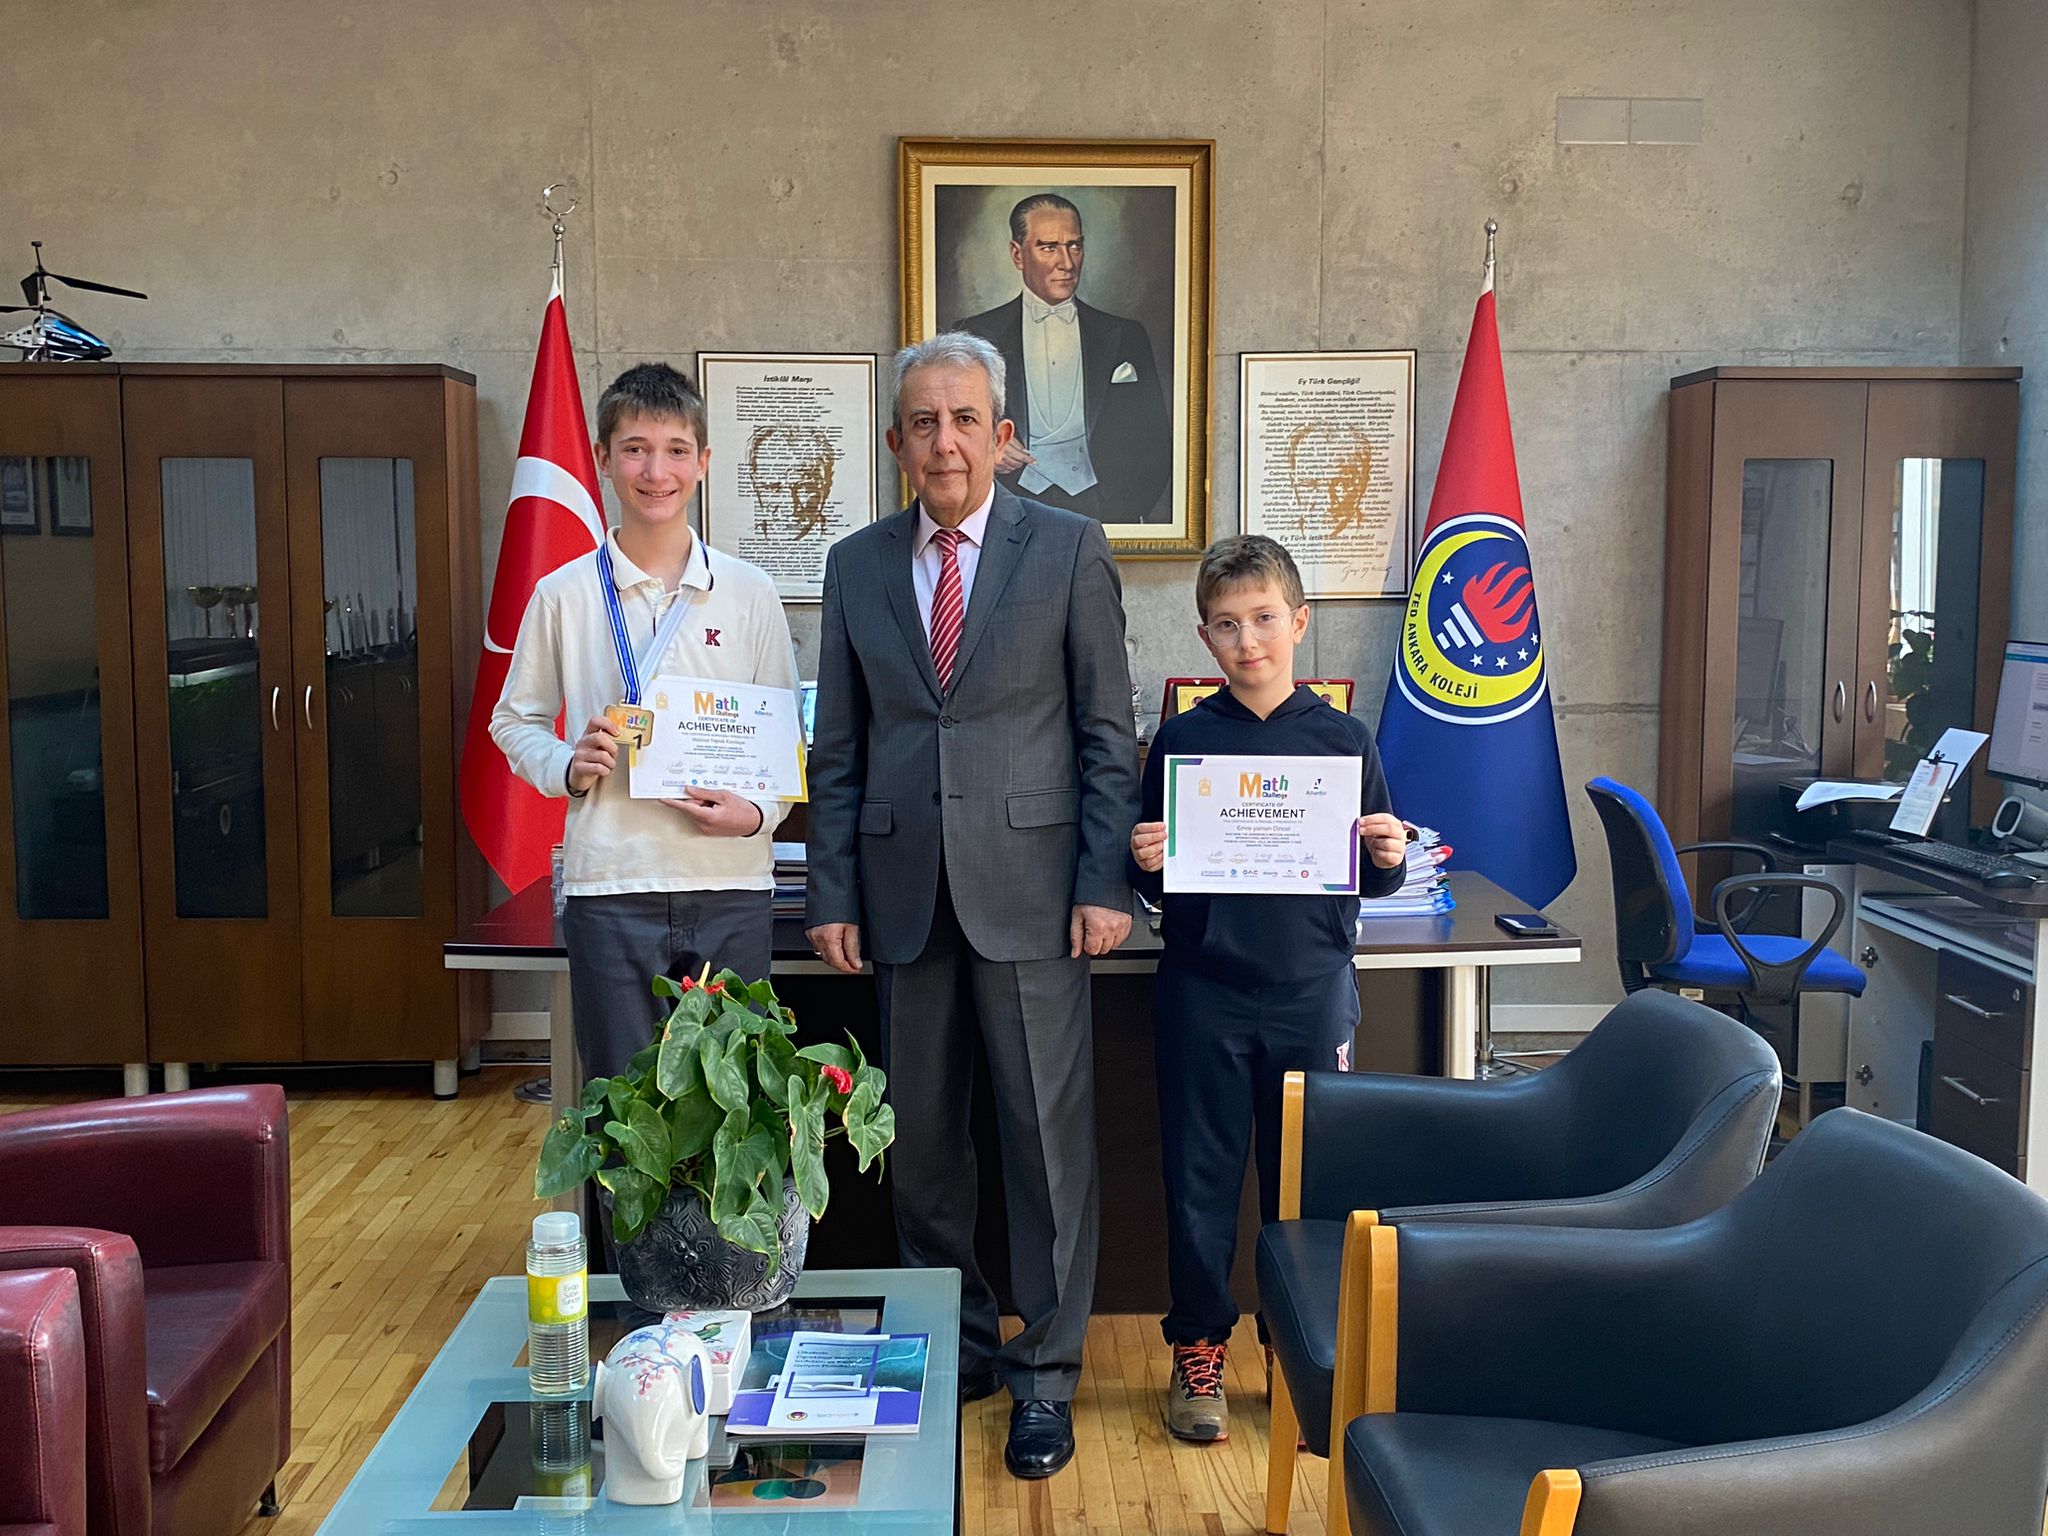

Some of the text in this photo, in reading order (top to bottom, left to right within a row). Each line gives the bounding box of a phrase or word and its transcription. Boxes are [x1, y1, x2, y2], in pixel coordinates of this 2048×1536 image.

[1298, 378, 1307, 386] Ey
[705, 628, 721, 647] K
[1408, 592, 1479, 699] TED ANKARA KOLEJİ
[694, 691, 739, 715] Math
[610, 711, 649, 728] Math
[678, 721, 757, 735] ACHIEVEMENT
[633, 734, 643, 750] 1
[1239, 772, 1289, 798] Math
[1262, 791, 1288, 800] Challenge
[1219, 808, 1306, 819] ACHIEVEMENT
